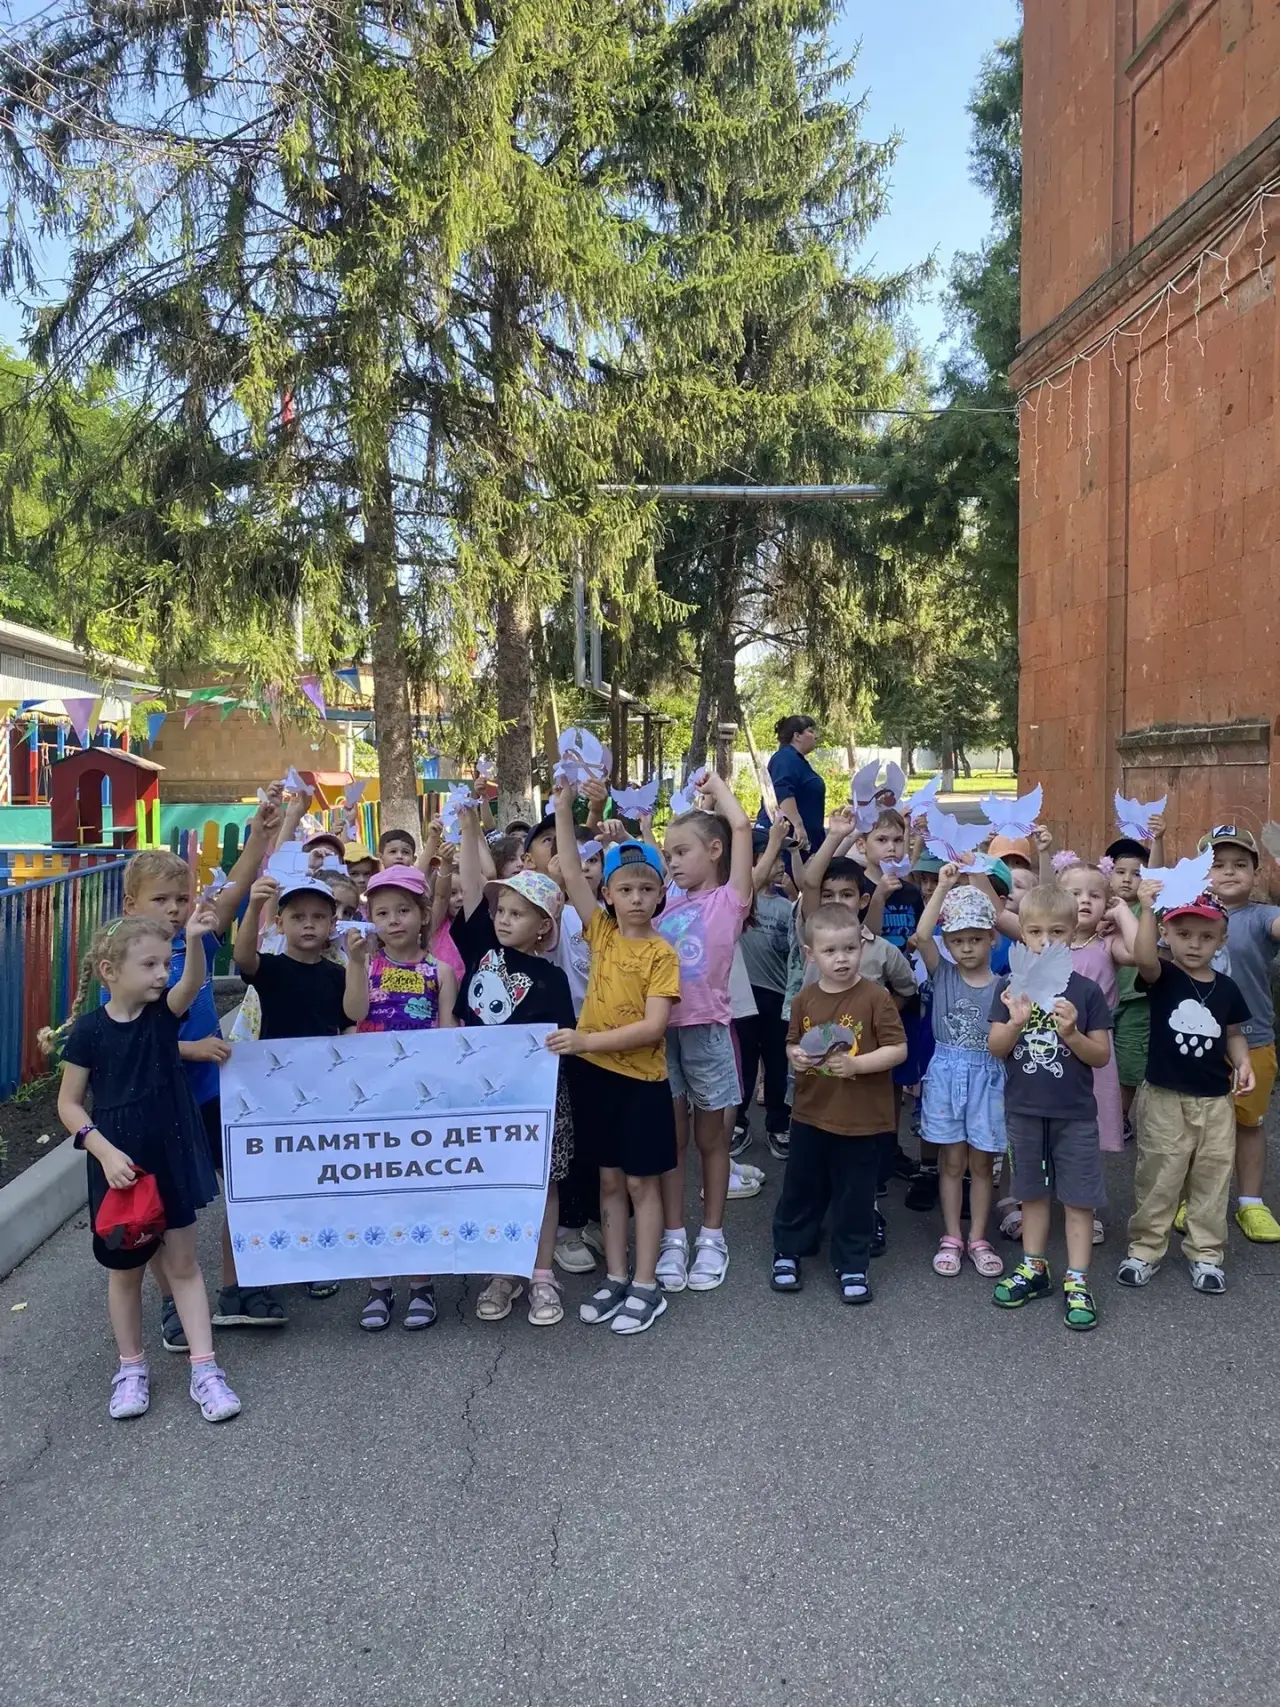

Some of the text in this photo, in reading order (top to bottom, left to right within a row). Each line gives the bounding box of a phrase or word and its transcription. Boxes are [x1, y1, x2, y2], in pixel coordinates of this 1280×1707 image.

[245, 1124, 540, 1155] В ПАМЯТЬ О ДЕТЯХ
[317, 1156, 485, 1185] ДОНБАССА
